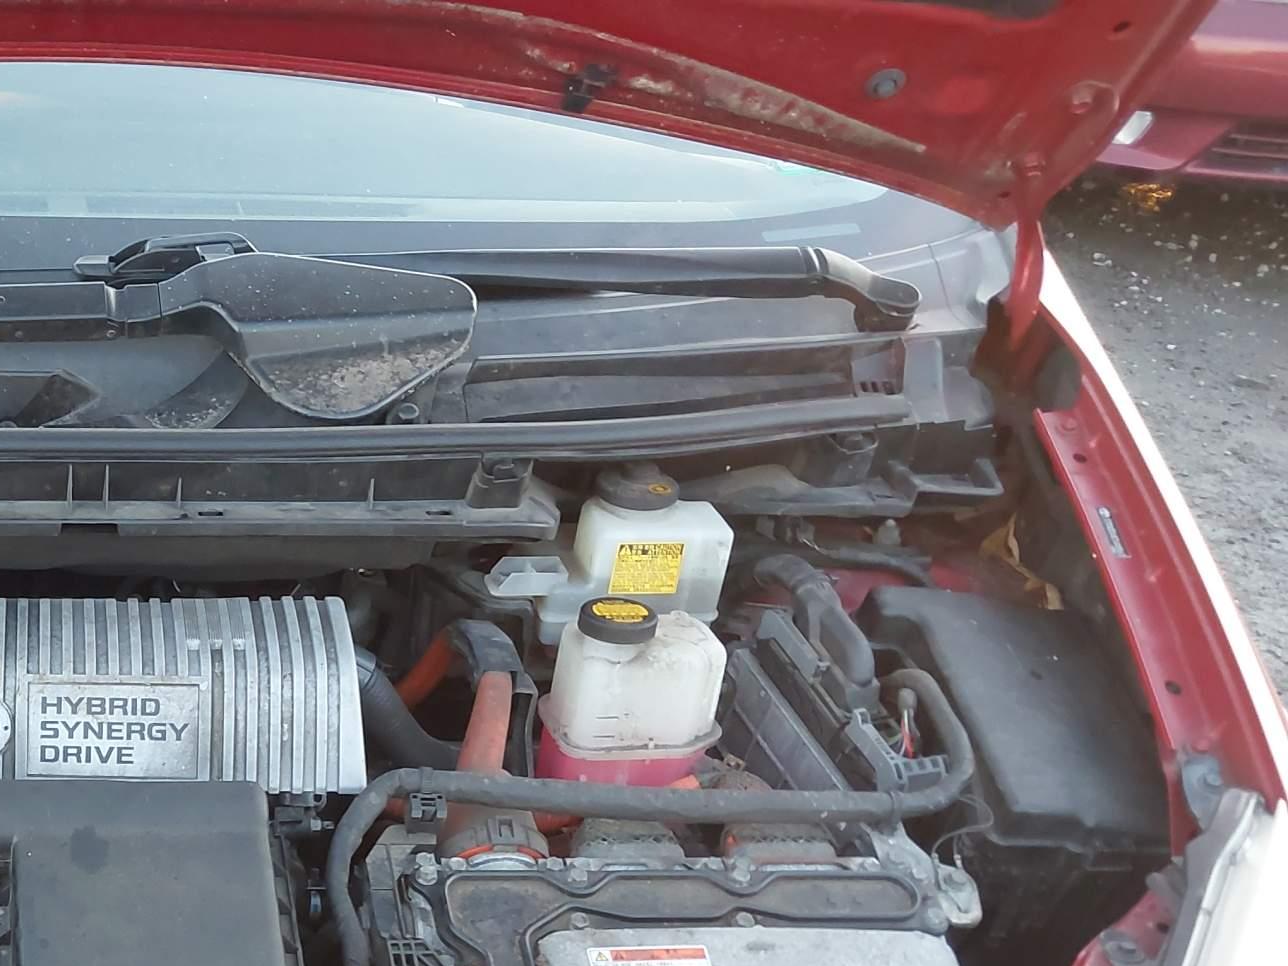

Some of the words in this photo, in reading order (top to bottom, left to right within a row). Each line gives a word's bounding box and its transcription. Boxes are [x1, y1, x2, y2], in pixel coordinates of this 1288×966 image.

[41, 696, 161, 716] HYBRID
[40, 720, 190, 741] SYNERGY
[40, 744, 135, 764] DRIVE
